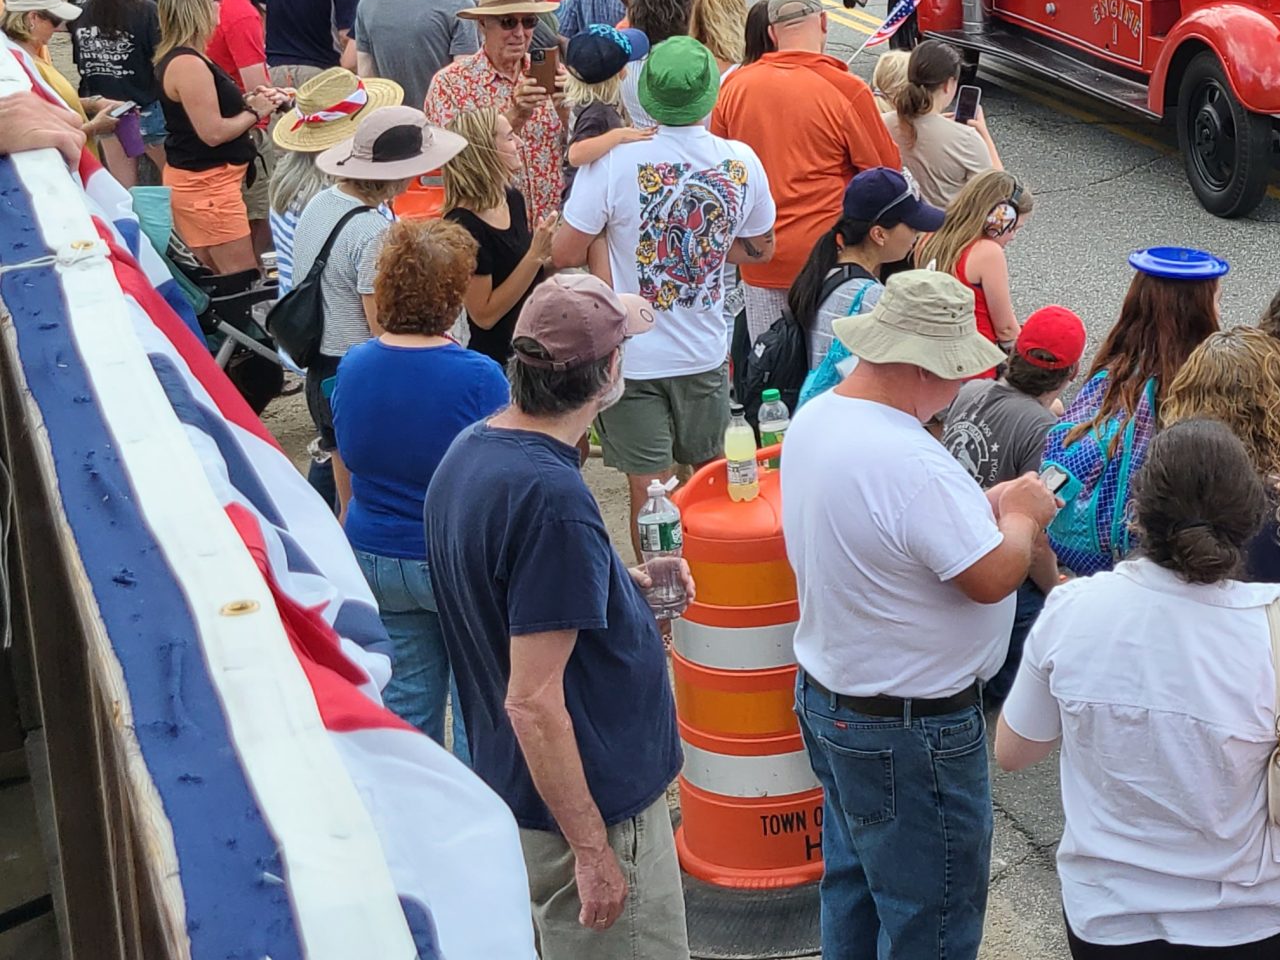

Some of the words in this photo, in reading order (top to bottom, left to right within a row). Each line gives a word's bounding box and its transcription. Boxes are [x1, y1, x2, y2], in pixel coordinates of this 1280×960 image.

[760, 809, 807, 837] TOWN
[813, 806, 824, 828] O
[805, 831, 823, 861] H
